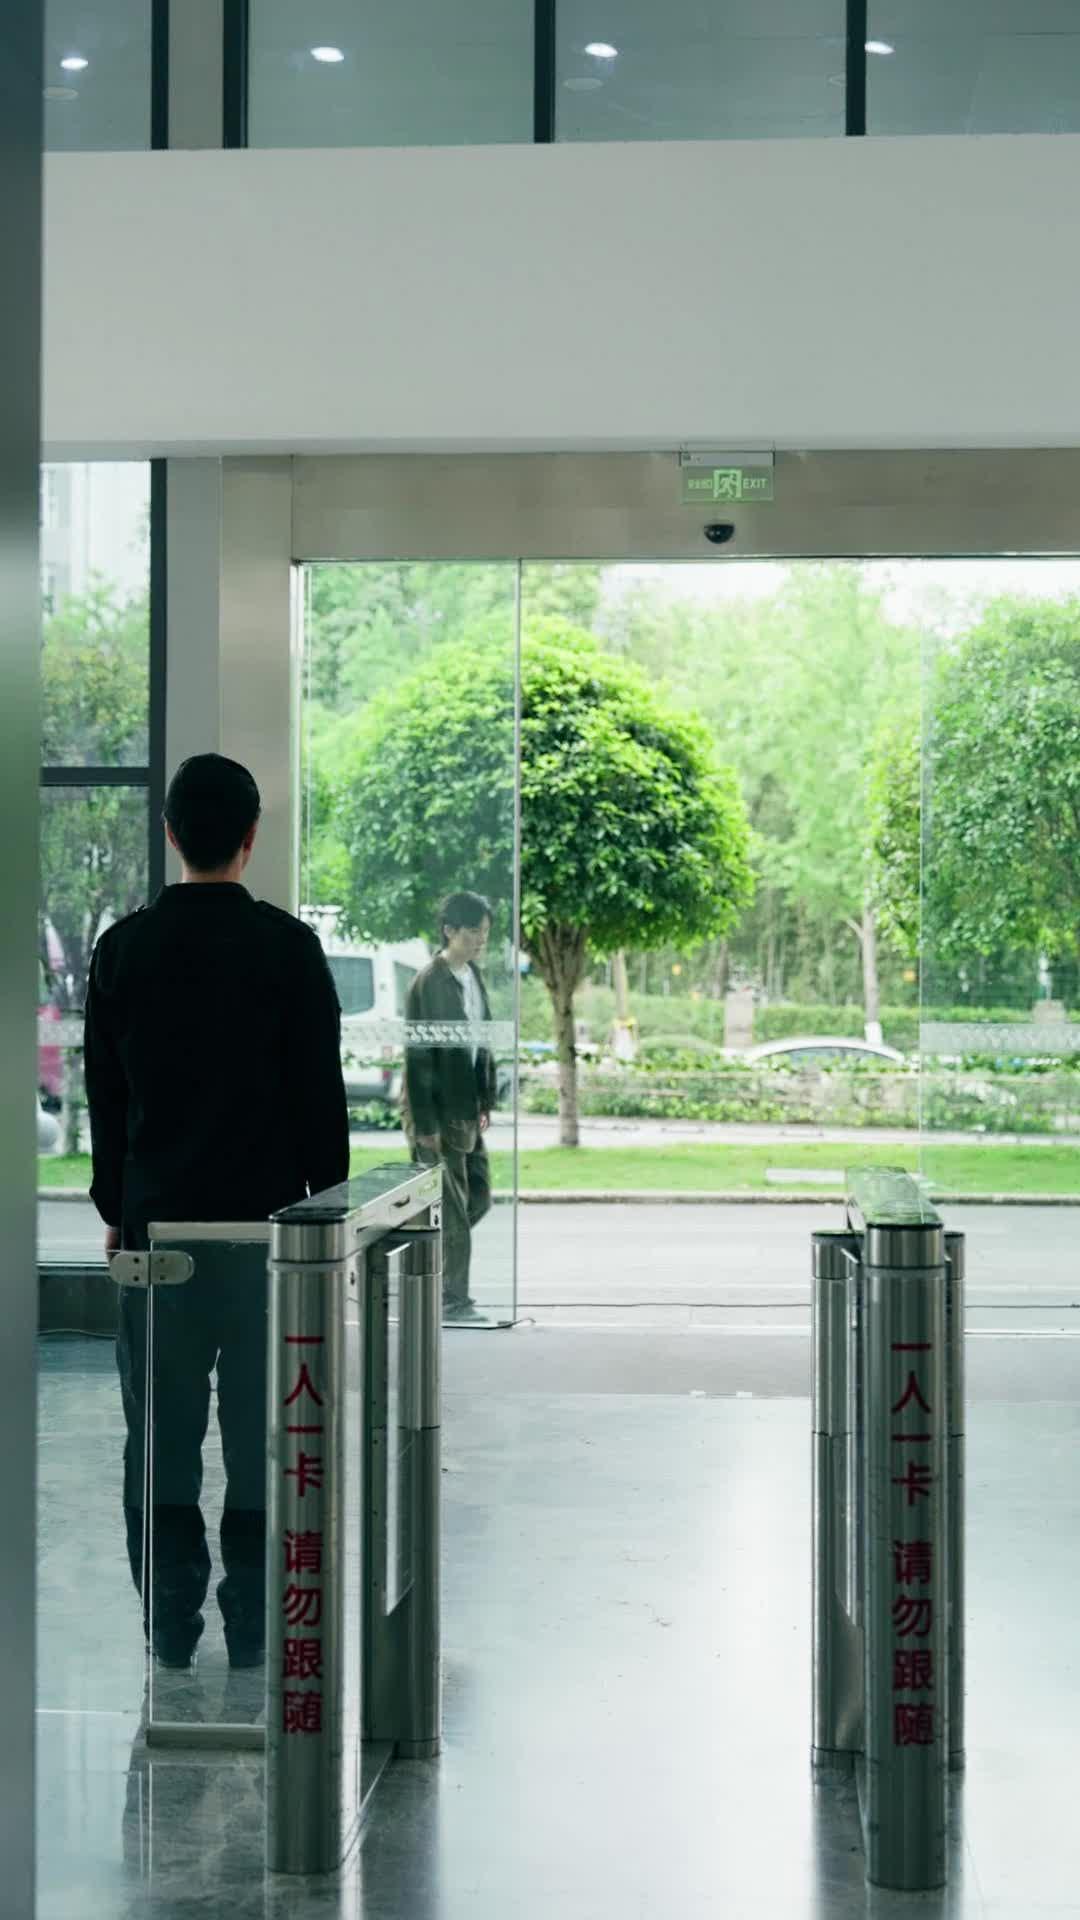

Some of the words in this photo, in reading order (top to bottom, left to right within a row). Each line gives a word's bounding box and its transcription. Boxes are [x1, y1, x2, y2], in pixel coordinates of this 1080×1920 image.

[742, 478, 768, 489] EXIT
[284, 1334, 324, 1498] 一人一卡
[891, 1343, 933, 1505] 一人一卡
[283, 1530, 324, 1734] 请勿跟随
[891, 1539, 934, 1746] 请勿跟随
